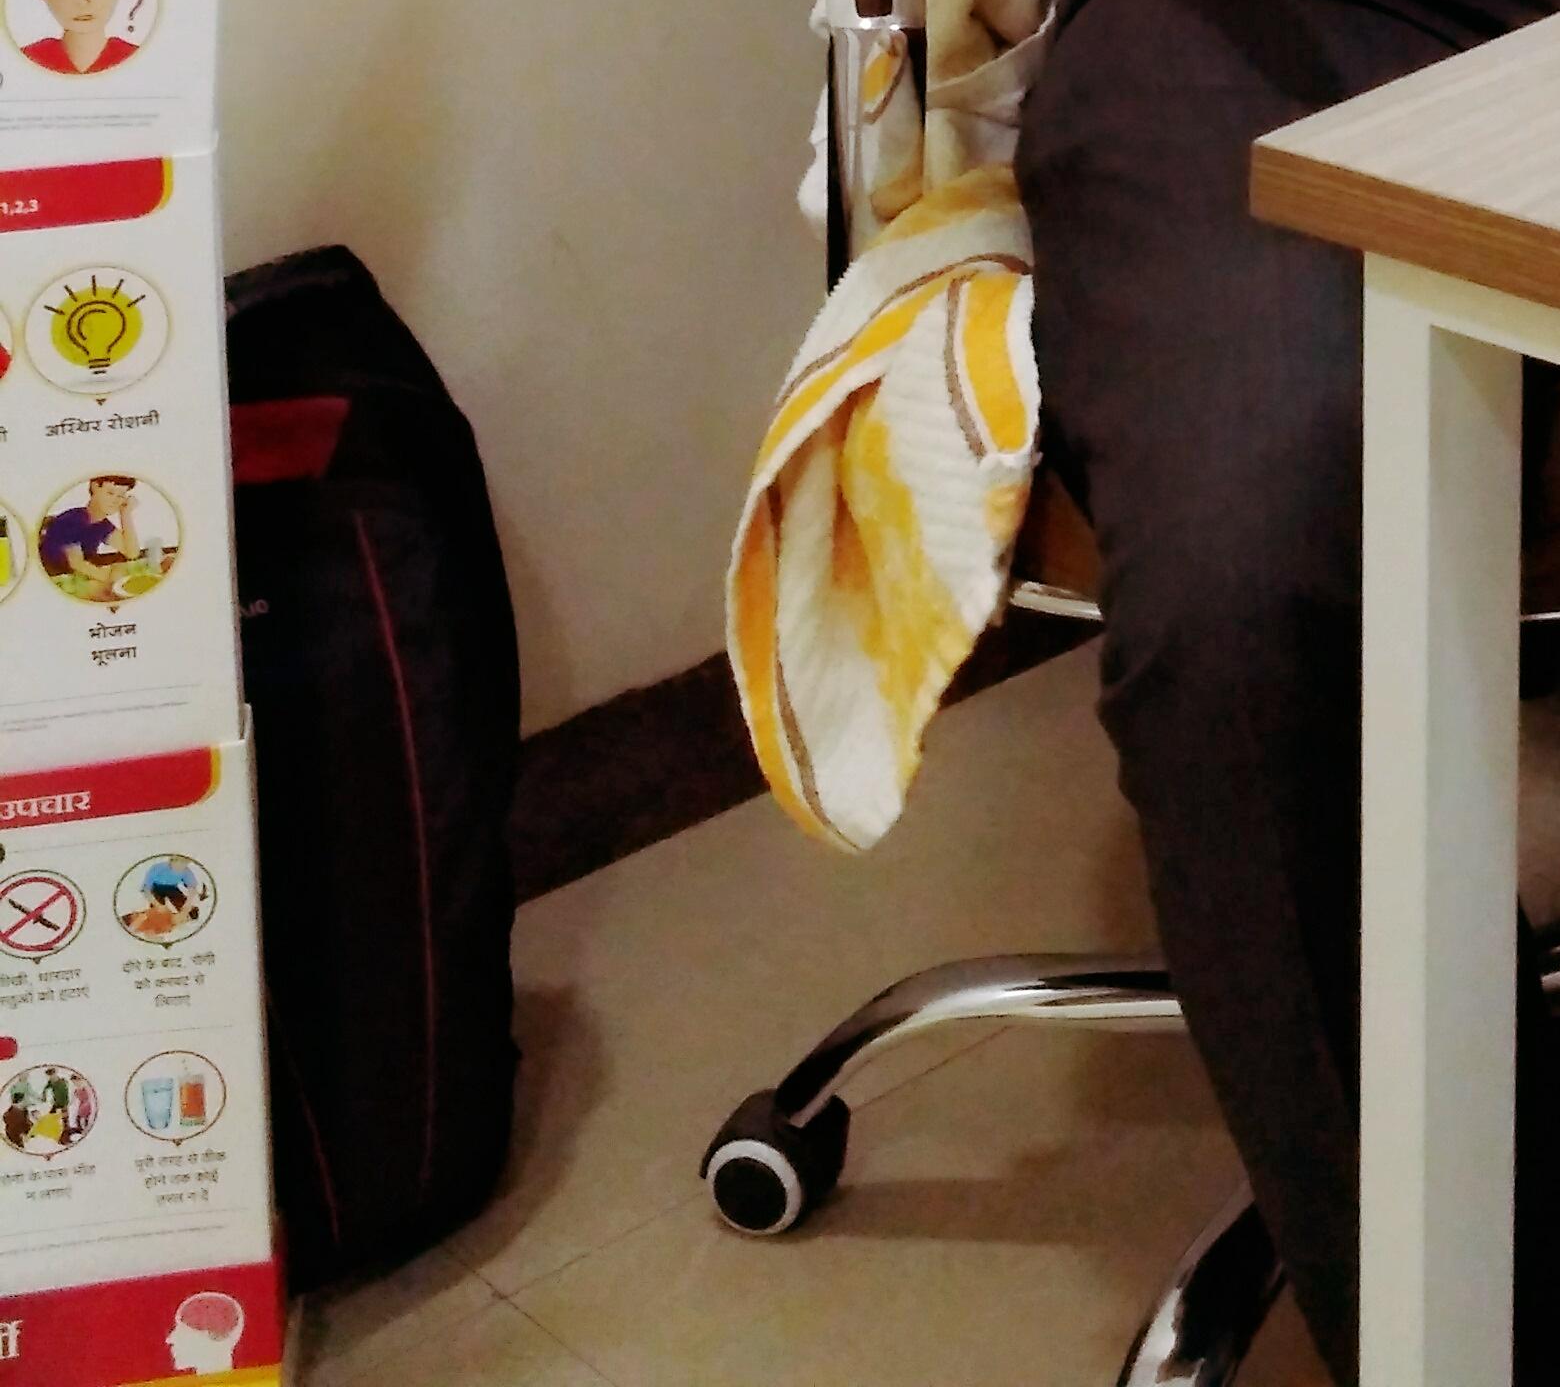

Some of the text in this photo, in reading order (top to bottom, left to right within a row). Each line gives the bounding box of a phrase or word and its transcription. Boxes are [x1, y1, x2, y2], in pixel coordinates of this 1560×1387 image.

[45, 409, 160, 437] अस्थिर रोशनी
[89, 622, 136, 638] भोजन
[91, 646, 136, 666] भूलना
[0, 790, 91, 820] उपचार
